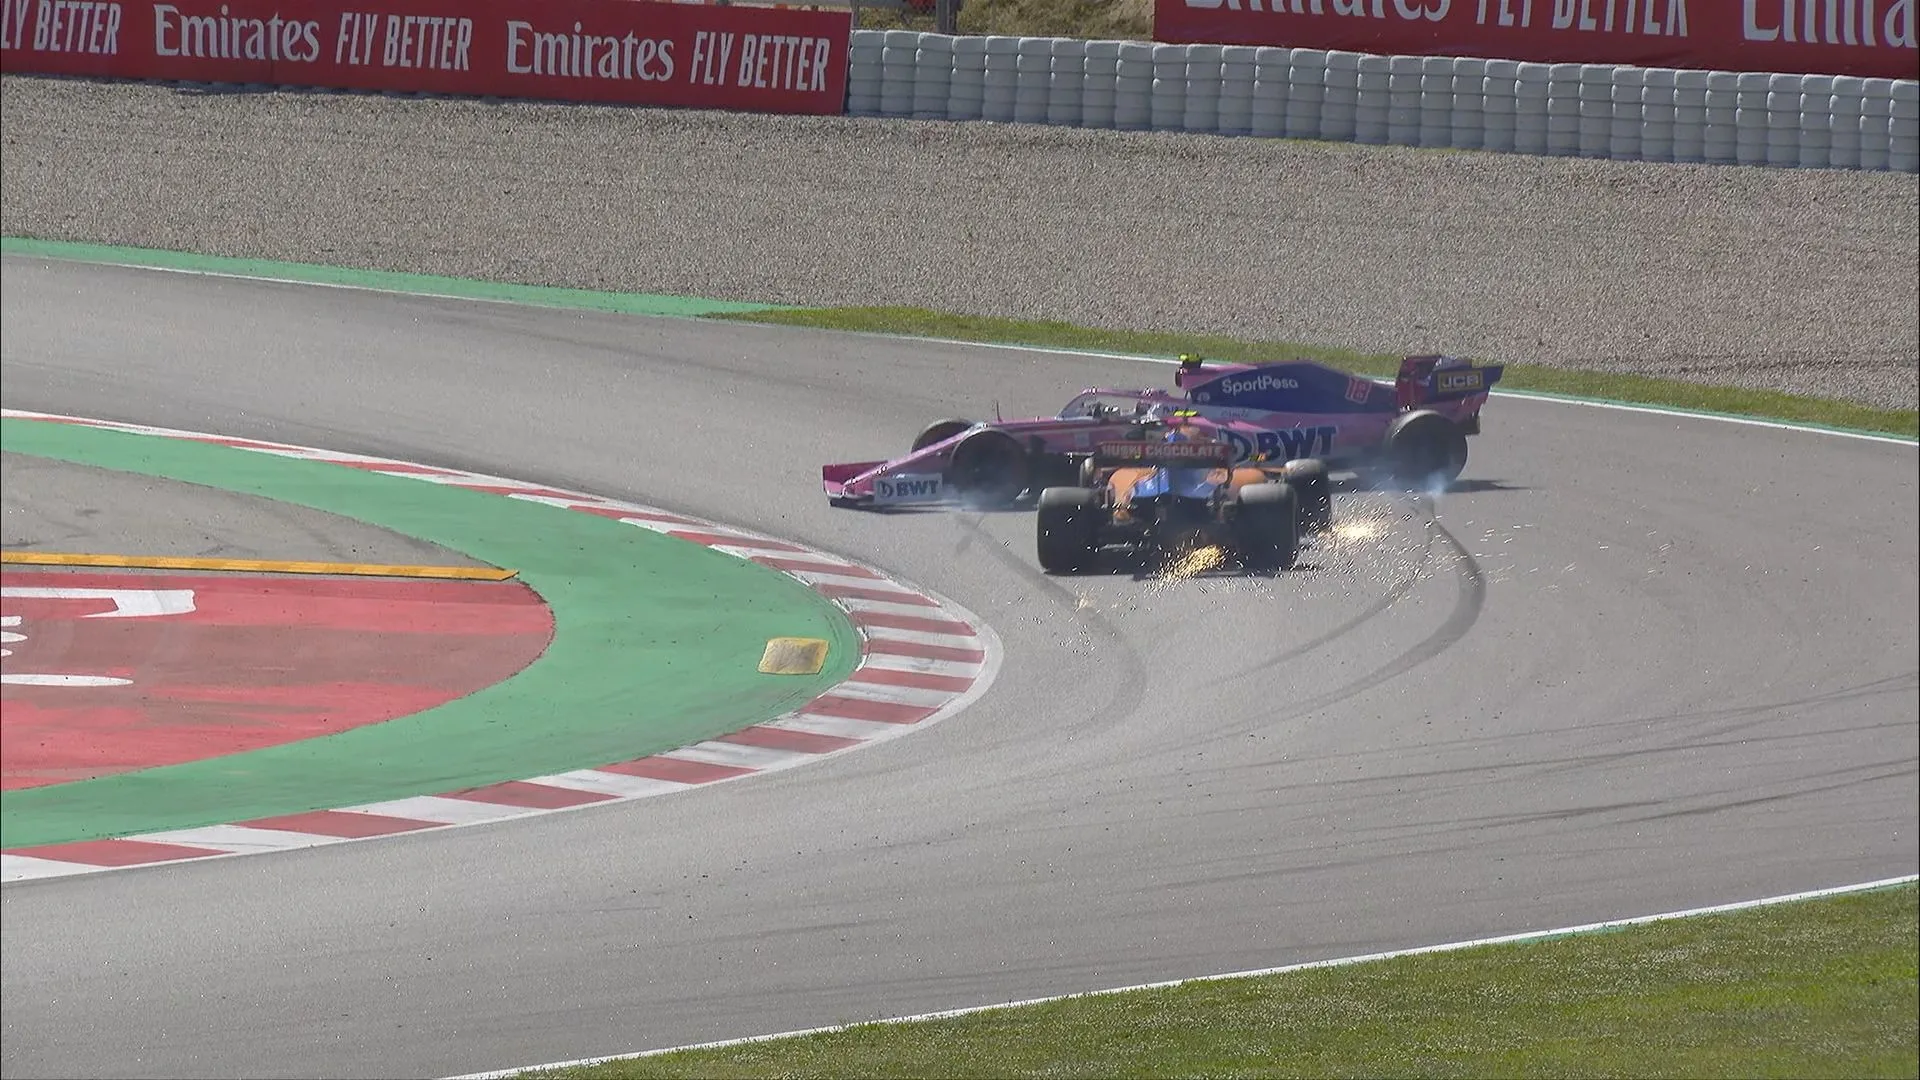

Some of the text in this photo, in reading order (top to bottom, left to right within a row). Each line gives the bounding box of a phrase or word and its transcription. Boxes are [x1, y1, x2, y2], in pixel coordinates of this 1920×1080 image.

[1, 0, 122, 55] LY BETTER
[154, 4, 473, 71] Emirates FLY BETTER
[506, 20, 830, 92] Emirates FLY BETTER
[1222, 375, 1299, 396] SportPesa
[1145, 444, 1225, 457] CHOCOLATE
[1255, 426, 1337, 461] BWT
[893, 480, 939, 497] BWT
